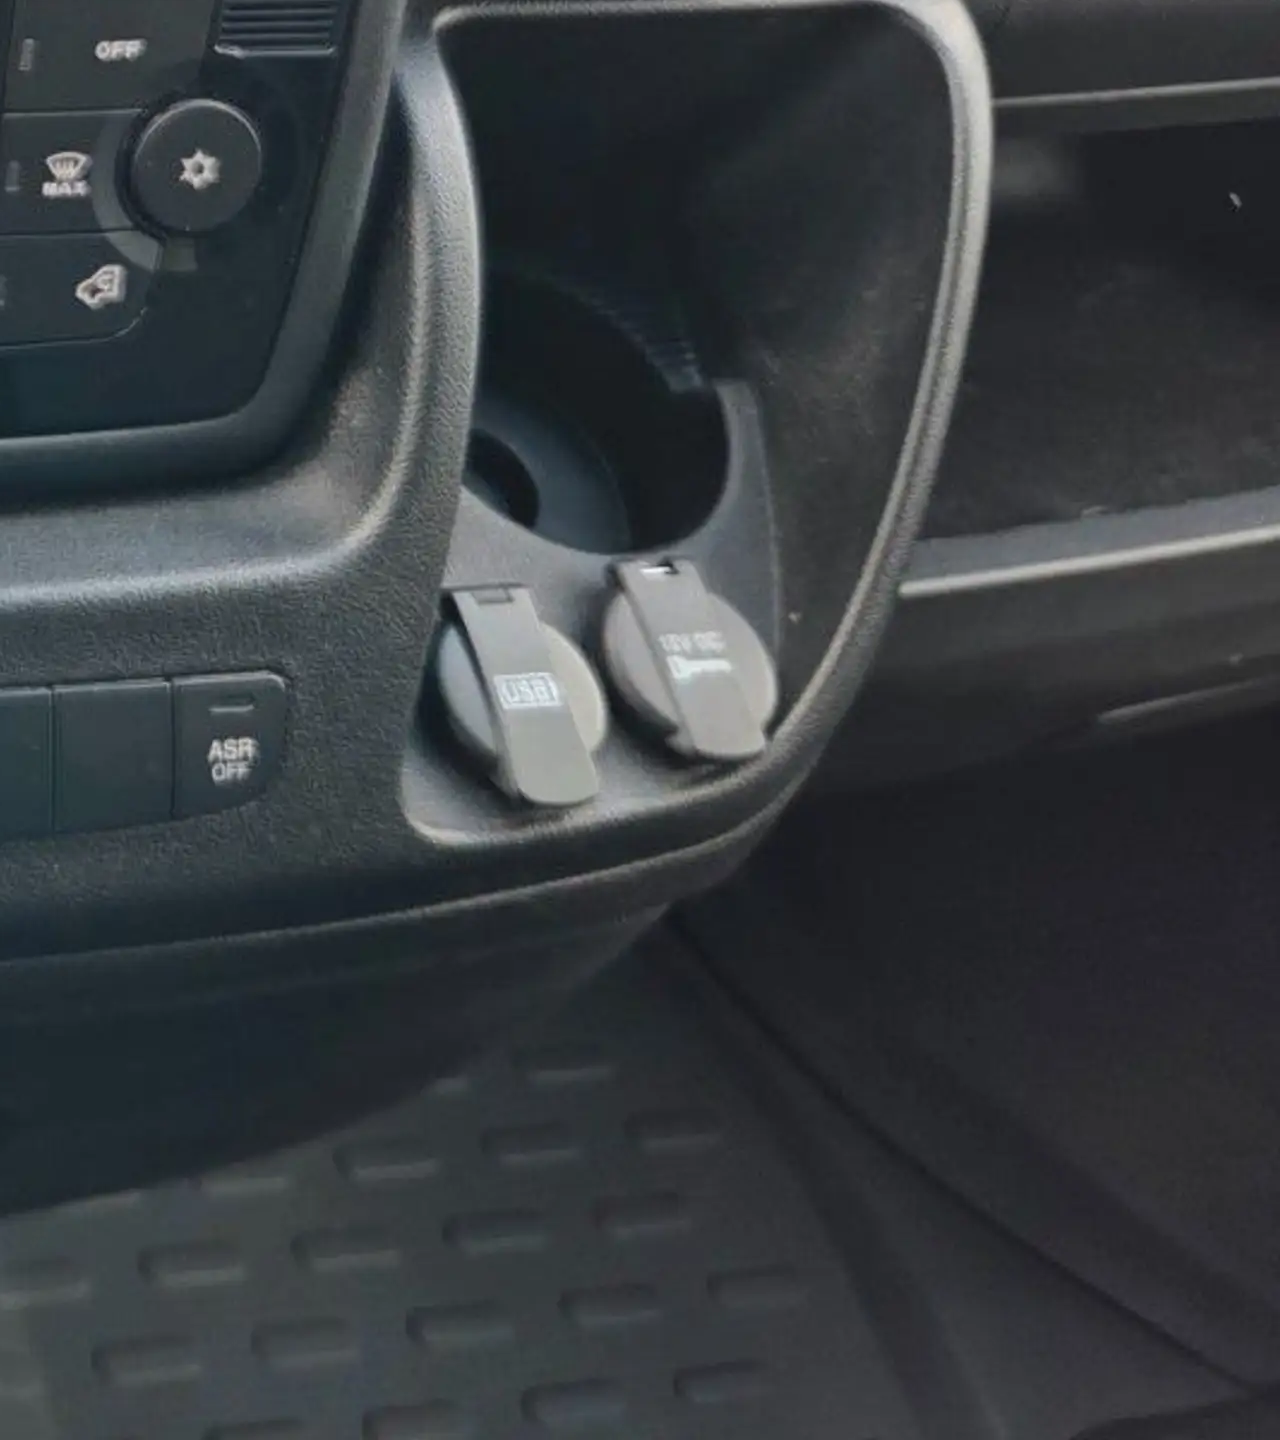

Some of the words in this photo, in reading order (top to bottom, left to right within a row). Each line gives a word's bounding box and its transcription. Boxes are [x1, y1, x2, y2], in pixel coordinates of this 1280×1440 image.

[94, 37, 147, 62] OFF
[41, 180, 90, 199] MAX
[502, 678, 552, 704] USB
[207, 736, 259, 763] ASR
[210, 762, 252, 784] OFF
